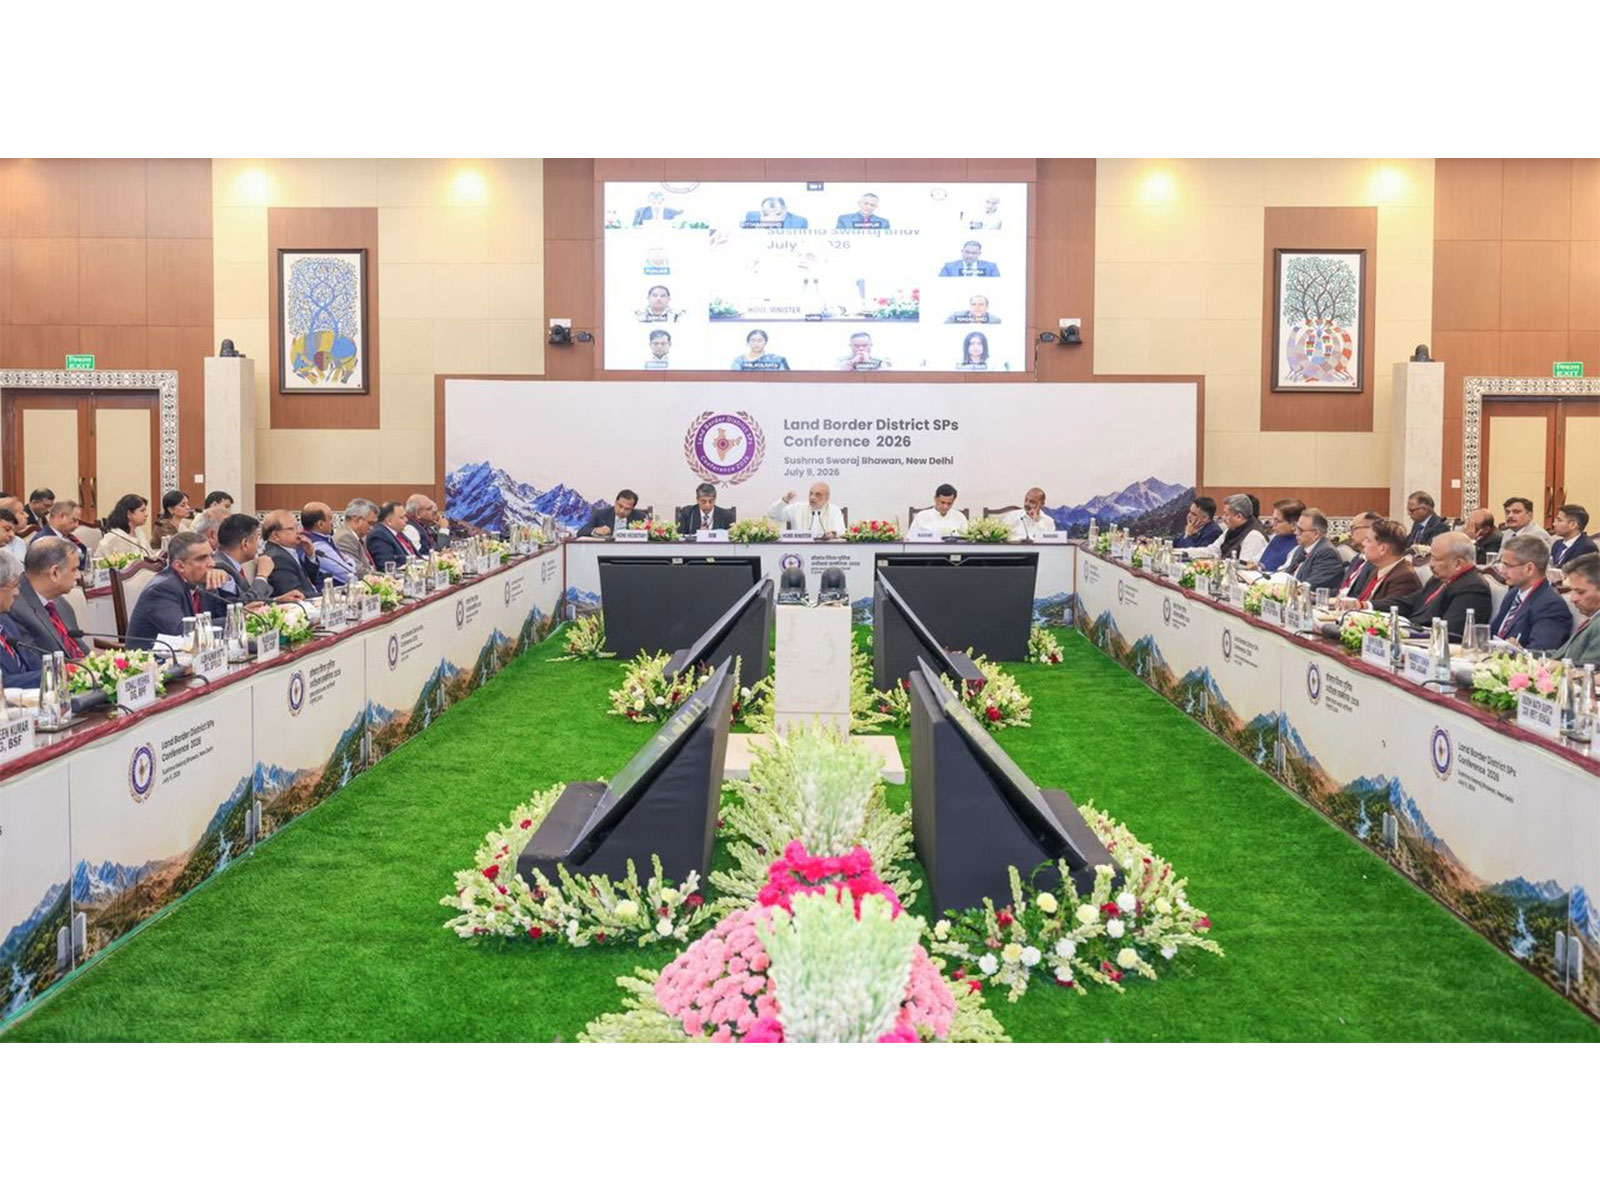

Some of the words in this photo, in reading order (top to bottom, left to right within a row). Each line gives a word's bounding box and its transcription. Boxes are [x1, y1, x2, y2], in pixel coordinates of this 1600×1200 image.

[766, 240, 797, 252] July
[784, 419, 820, 431] Land
[823, 419, 873, 431] Border
[876, 419, 929, 431] District
[933, 419, 959, 431] SPs
[784, 435, 870, 448] Conference
[876, 436, 911, 447] 2026
[784, 456, 824, 465] Sushma
[826, 456, 860, 467] Swaraj
[862, 456, 904, 466] Bhawan,
[906, 456, 927, 465] New
[929, 456, 954, 465] Delhi
[784, 468, 804, 478] July
[806, 468, 814, 477] 9,
[816, 468, 840, 476] 2026
[9, 720, 29, 736] KUMAR
[8, 734, 22, 750] BSF
[162, 736, 174, 750] Land
[174, 731, 190, 745] Border
[162, 744, 189, 762] Conference
[190, 736, 201, 749] 2026
[1458, 741, 1470, 754] Land
[1470, 747, 1487, 761] Border
[1458, 754, 1486, 775] Conference
[1487, 768, 1499, 782] 2026
